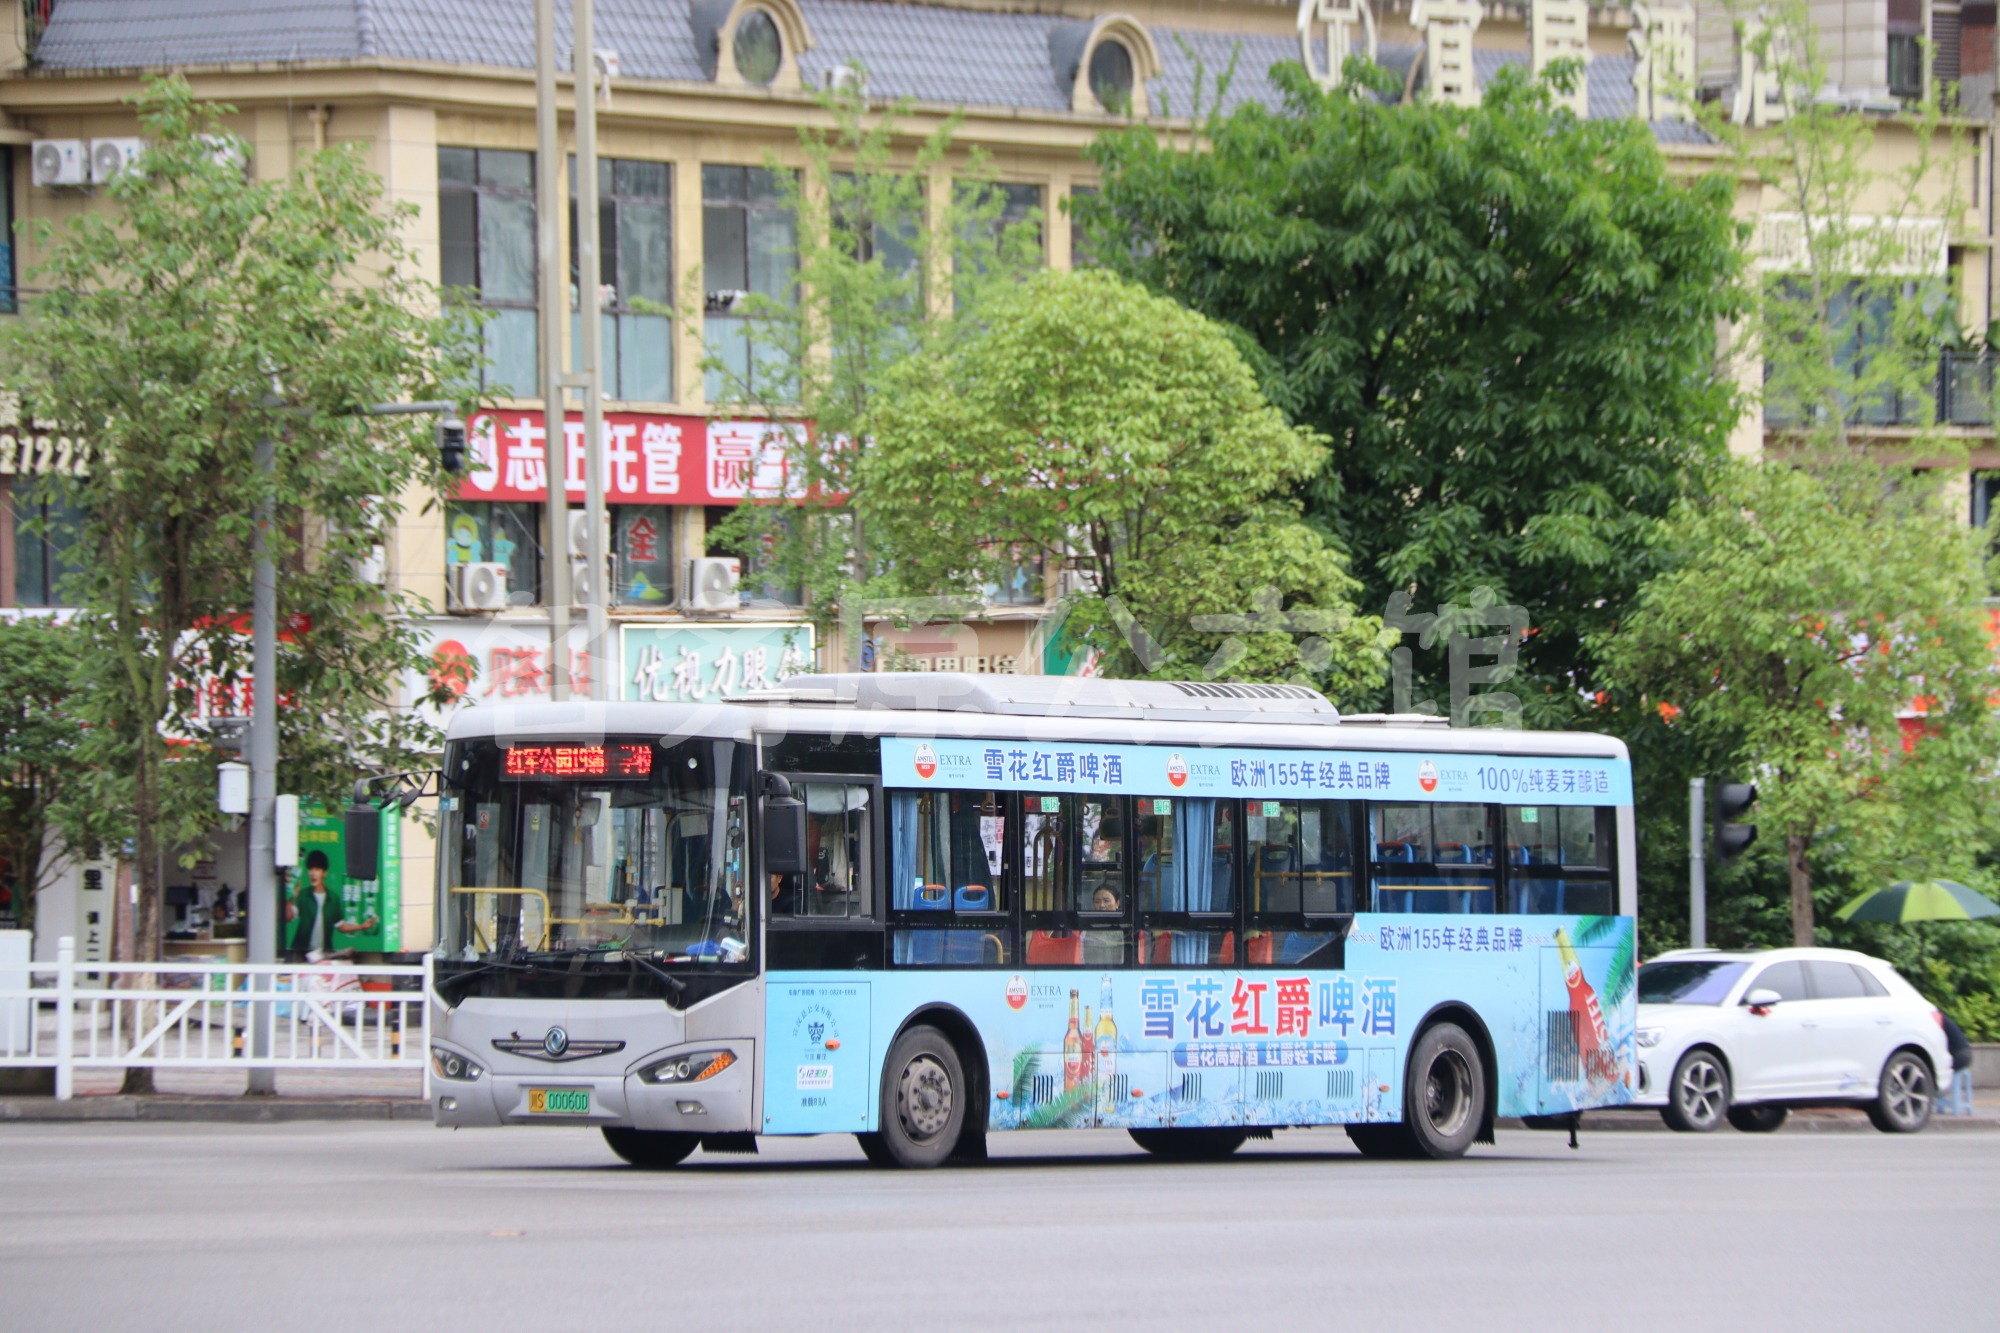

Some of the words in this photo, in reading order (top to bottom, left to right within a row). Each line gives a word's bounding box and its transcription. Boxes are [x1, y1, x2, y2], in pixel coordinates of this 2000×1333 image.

[917, 755, 934, 763] AMSTEL
[940, 754, 972, 766] EXTRA
[983, 748, 1123, 785] 雪花红爵啤酒
[1190, 764, 1220, 775] EXTRA
[1230, 758, 1391, 790] 欧洲155年经典品牌
[1440, 770, 1469, 780] EXTRA
[1477, 767, 1609, 793] 100%纯麦芽酿造
[1379, 925, 1524, 952] 欧洲155年经典品牌
[1030, 985, 1062, 996] EXTRA
[1140, 976, 1398, 1040] 雪花红爵啤酒
[1186, 1041, 1259, 1067] 雪花高端酒
